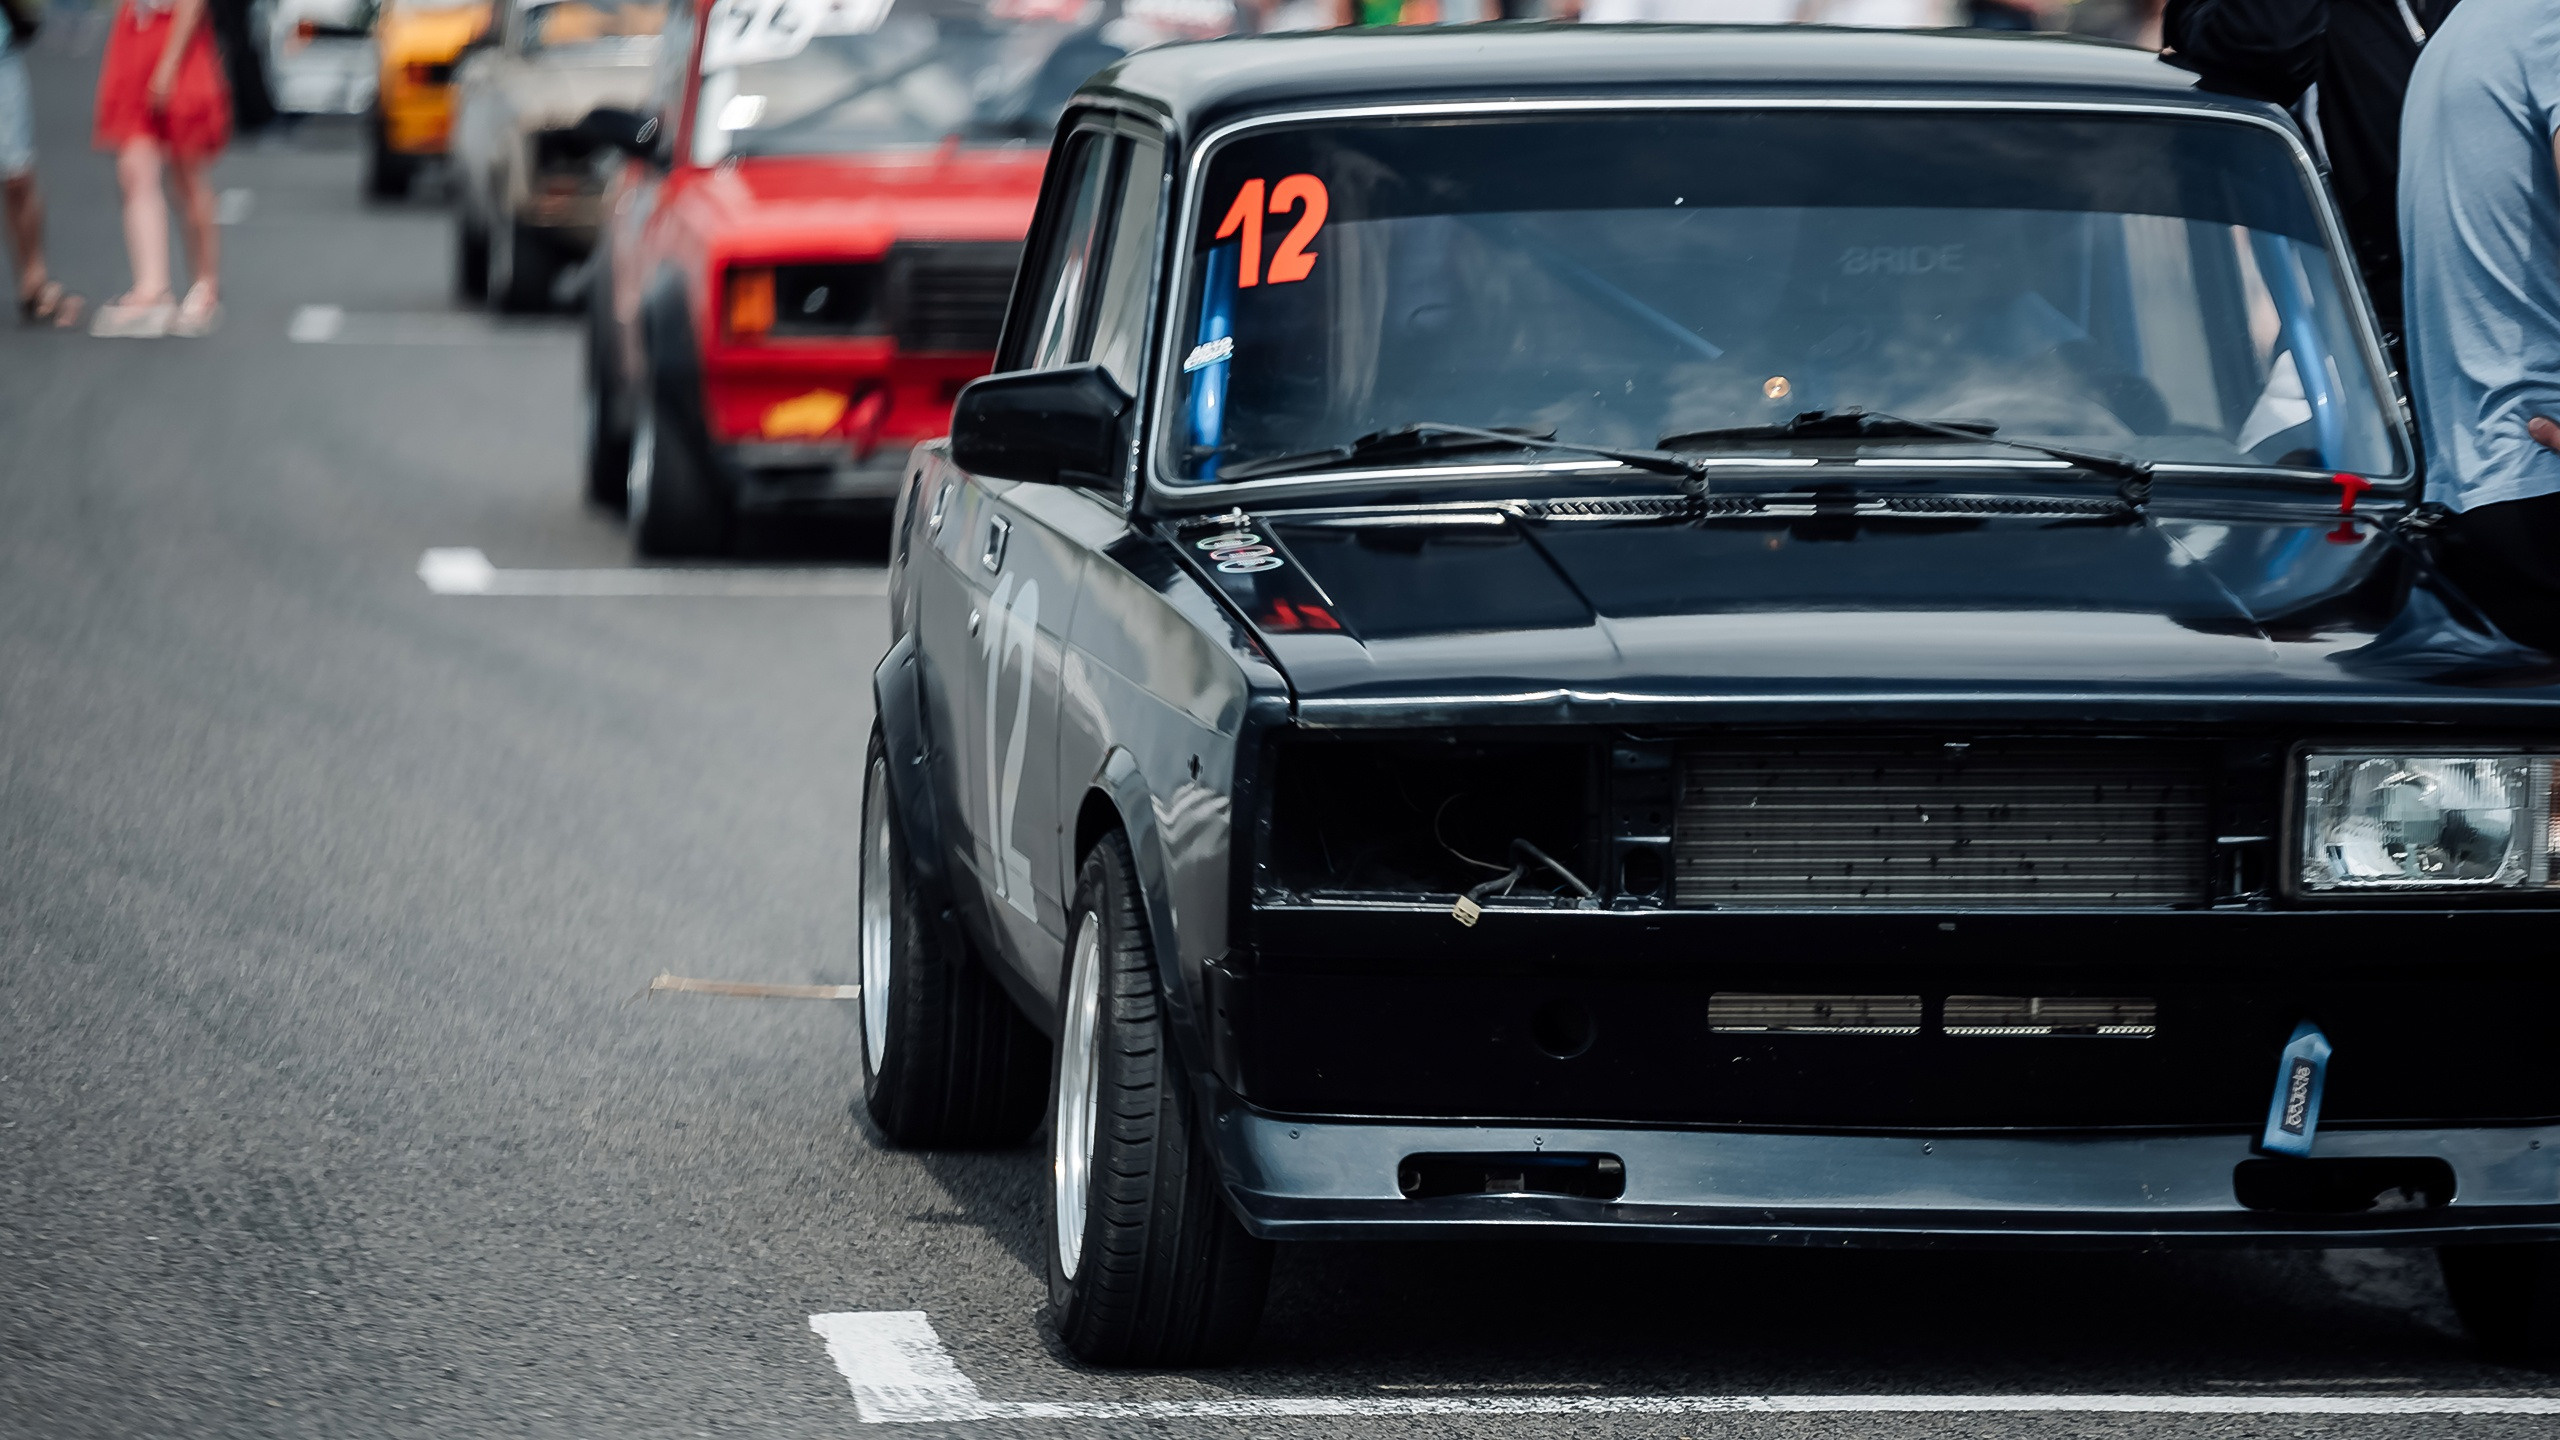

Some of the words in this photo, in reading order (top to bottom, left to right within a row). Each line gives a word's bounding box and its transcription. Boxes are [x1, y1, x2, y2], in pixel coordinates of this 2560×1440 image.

[1215, 173, 1329, 288] 12
[1839, 244, 1965, 275] BRIDE
[981, 570, 1039, 923] 12
